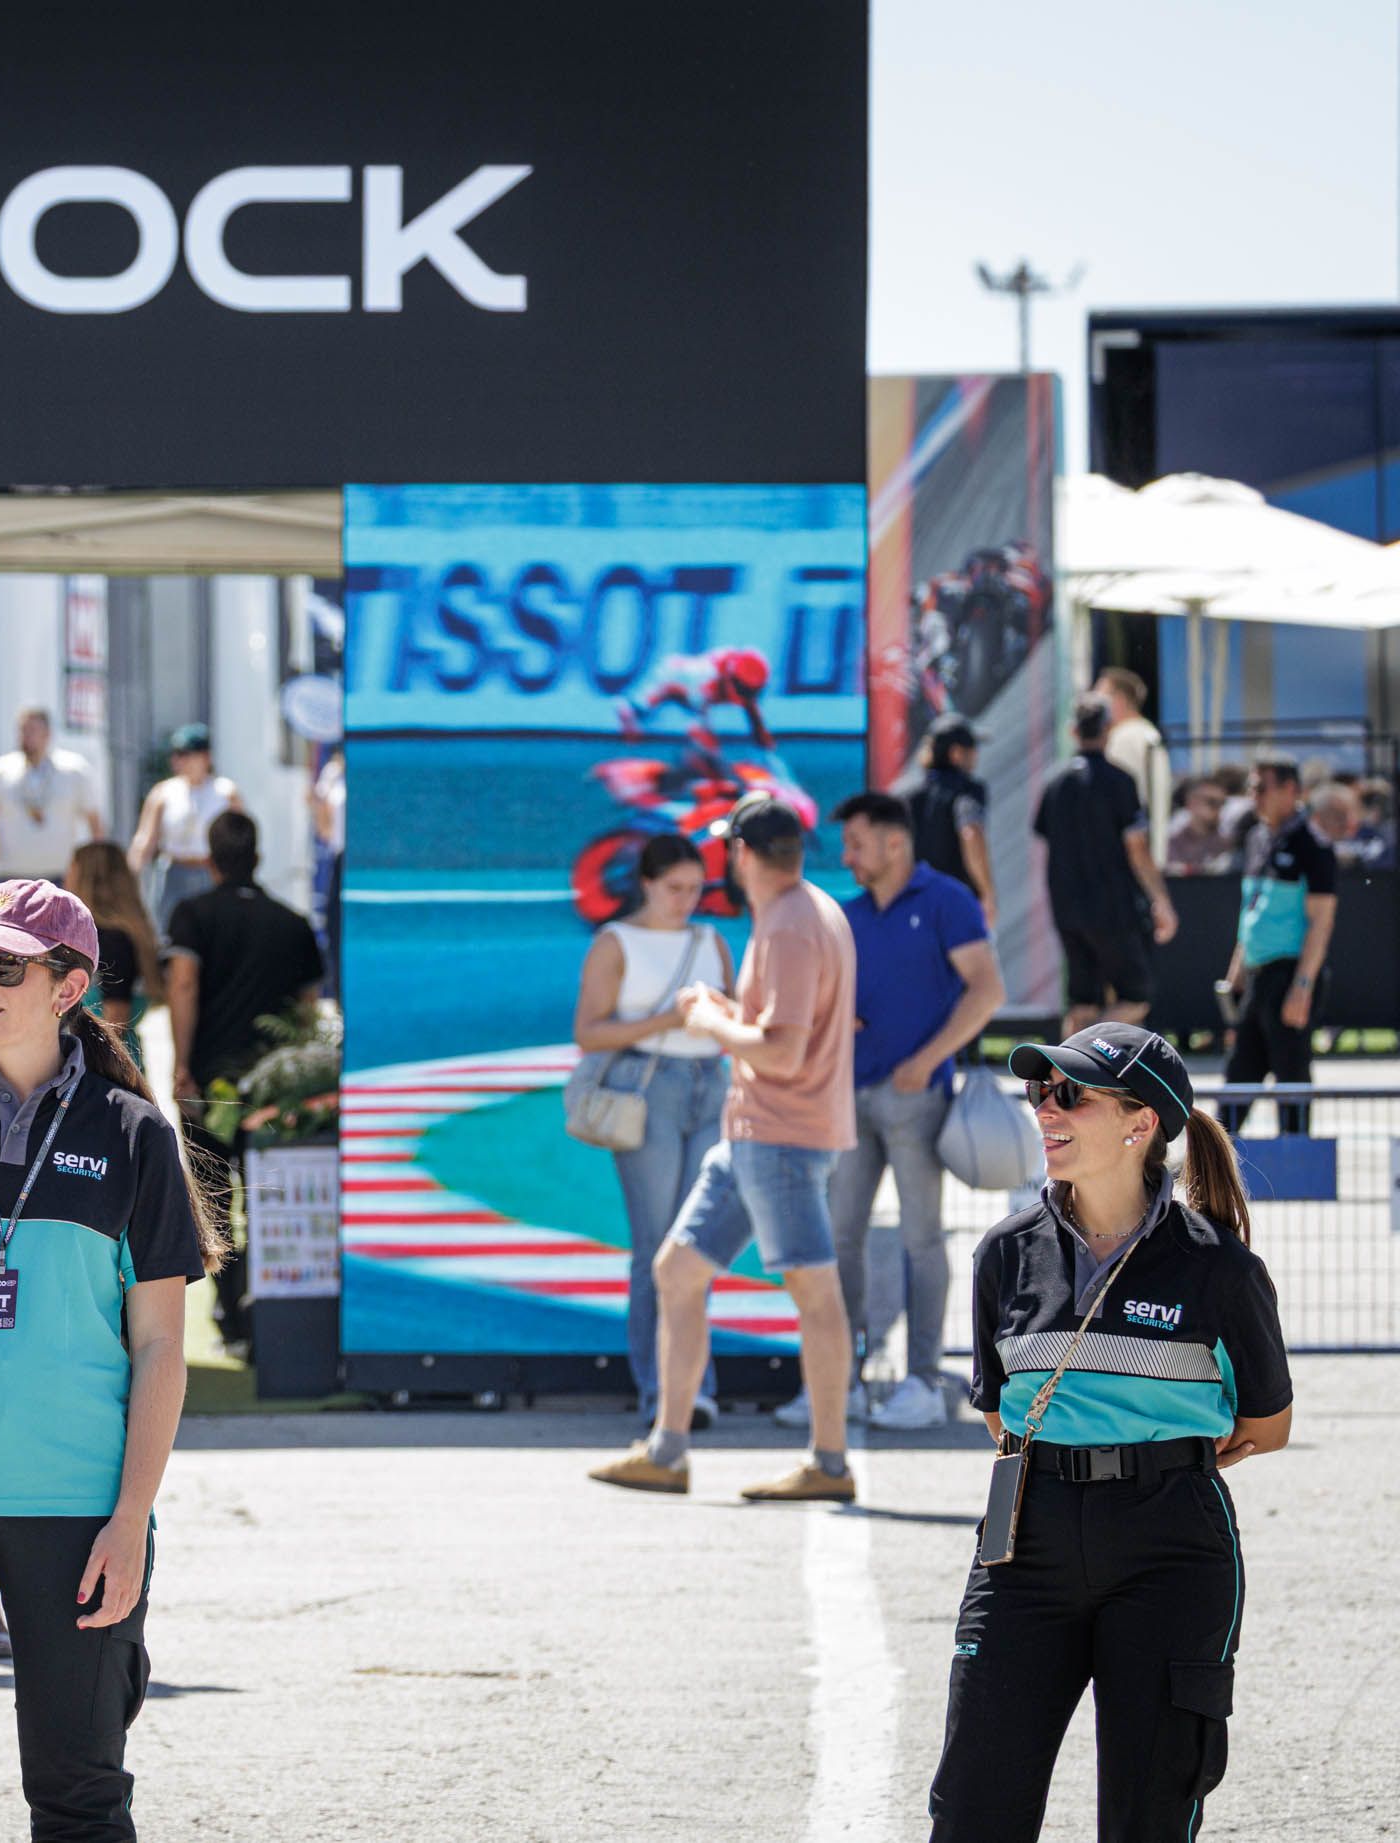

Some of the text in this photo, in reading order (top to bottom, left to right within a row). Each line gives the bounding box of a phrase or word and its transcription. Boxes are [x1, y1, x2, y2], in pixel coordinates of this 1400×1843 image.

[53, 1151, 108, 1175] servi
[56, 1165, 103, 1181] SECURITAS
[1122, 1299, 1183, 1325] servi
[1127, 1314, 1175, 1331] SECURITAS
